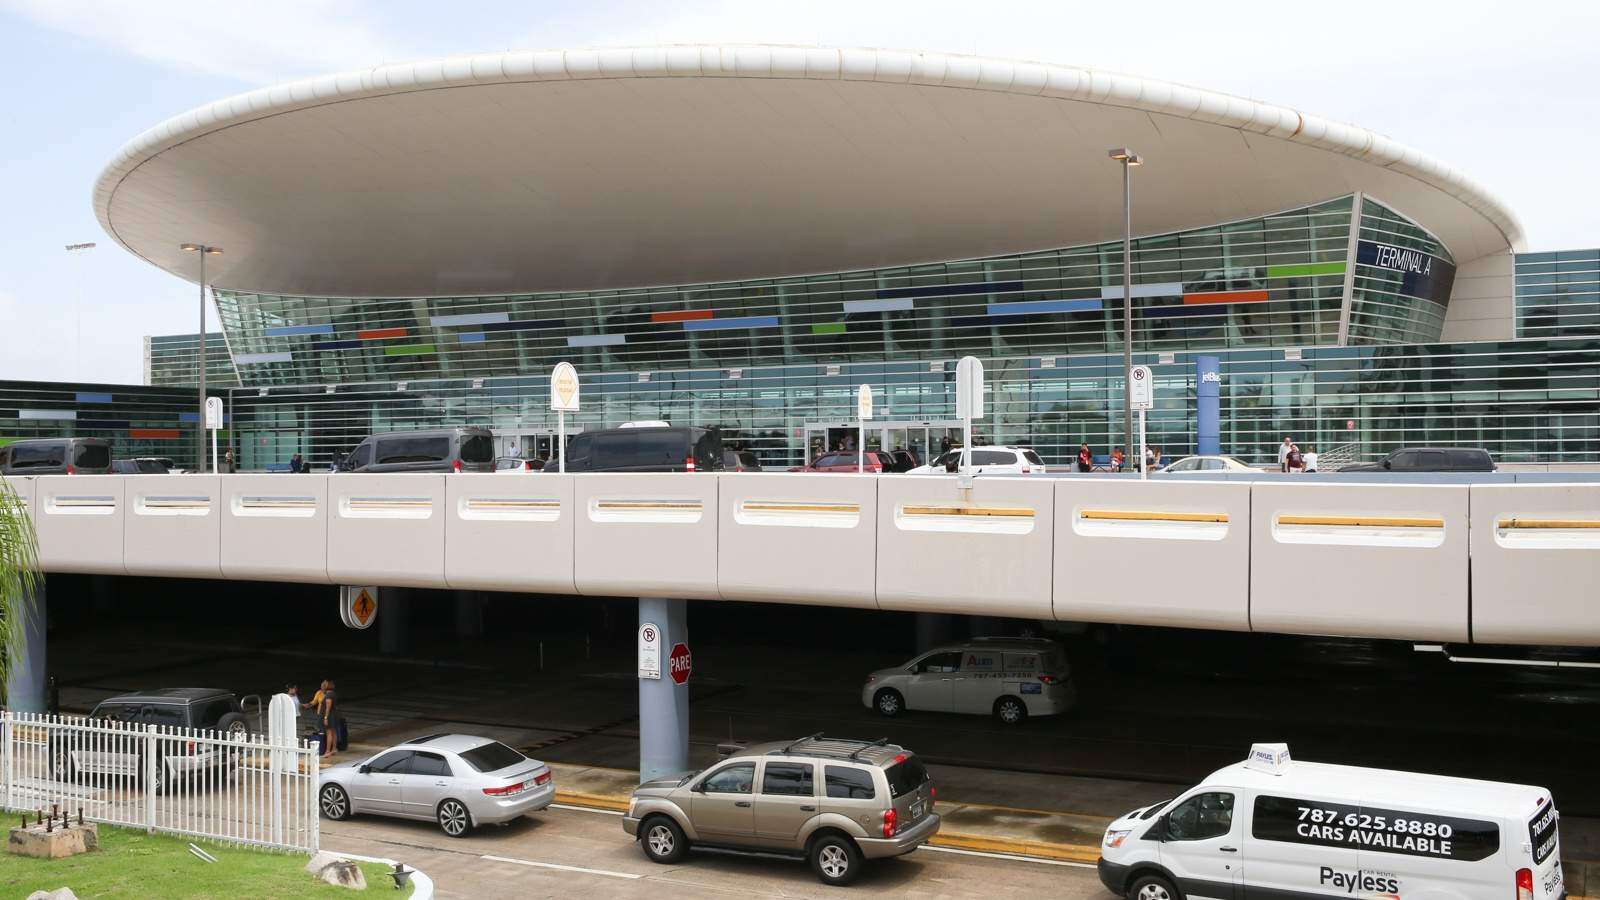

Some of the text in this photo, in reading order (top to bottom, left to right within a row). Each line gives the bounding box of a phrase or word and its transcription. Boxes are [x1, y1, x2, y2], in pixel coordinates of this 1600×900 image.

[1376, 245, 1432, 276] TERMINAL A
[670, 655, 690, 673] PARE
[1298, 807, 1452, 838] 787.625.8880
[1297, 823, 1452, 855] CARS AVAILABLE
[1320, 866, 1399, 893] Payless
